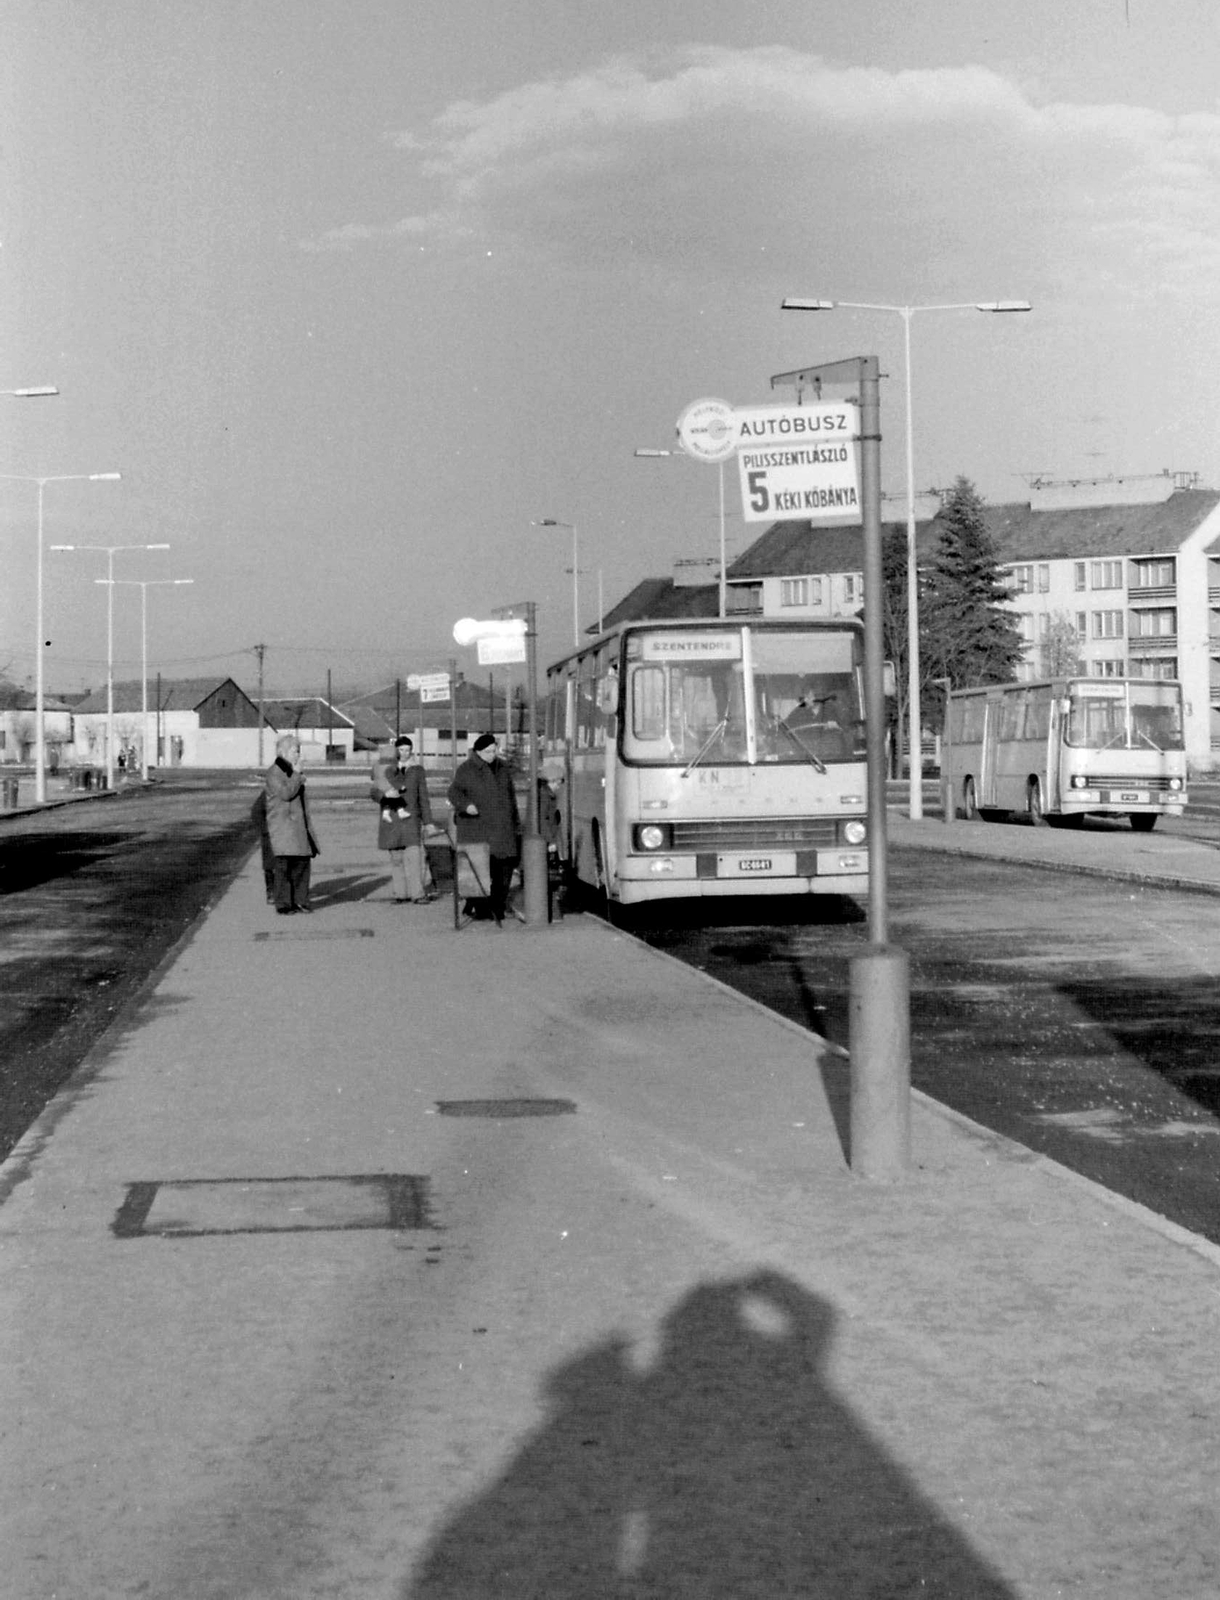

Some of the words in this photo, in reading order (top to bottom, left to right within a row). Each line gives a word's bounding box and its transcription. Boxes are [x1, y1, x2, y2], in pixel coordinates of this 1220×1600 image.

[740, 415, 847, 436] AUTÓBUSZ
[743, 444, 848, 468] PILISSZENTLÁSZLÓ
[748, 471, 769, 513] 5
[774, 488, 802, 511] KÉKI
[804, 484, 857, 509] KŐBÁNYA
